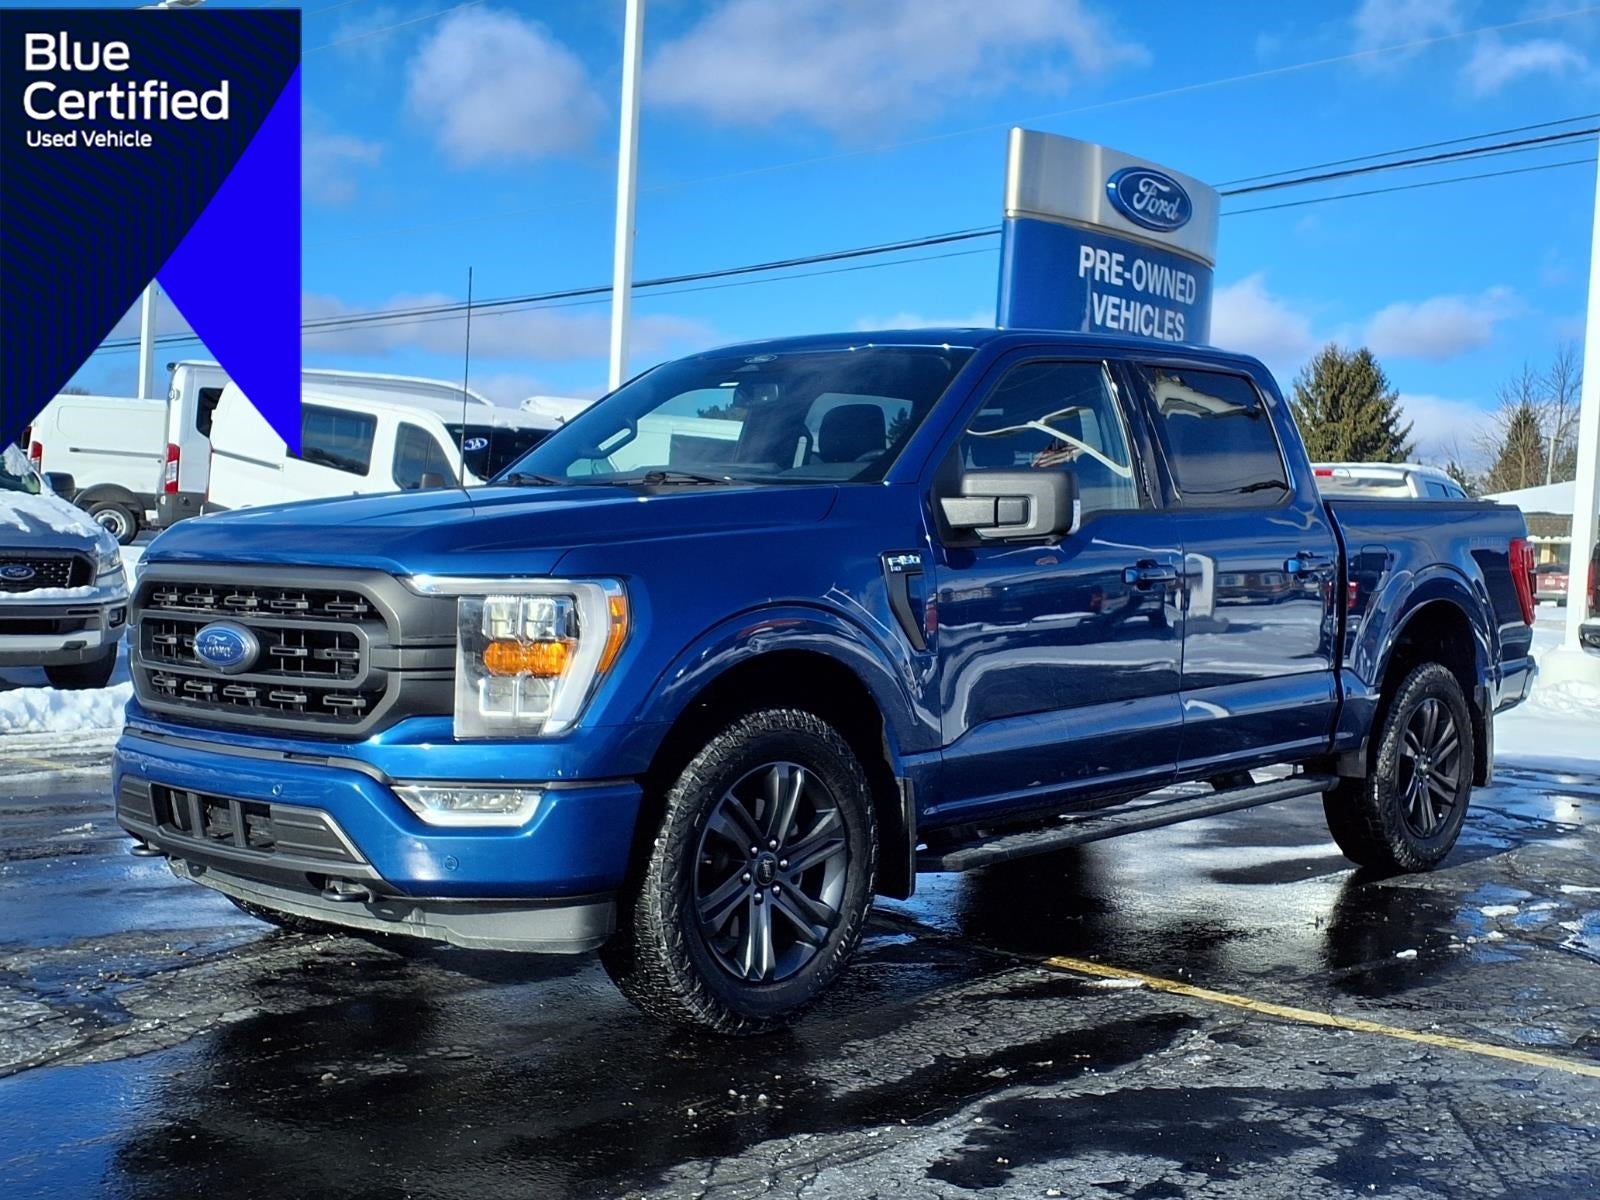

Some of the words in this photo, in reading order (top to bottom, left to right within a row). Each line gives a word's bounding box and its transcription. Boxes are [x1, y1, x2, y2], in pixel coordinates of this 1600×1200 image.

[1132, 177, 1181, 220] Ford
[1078, 245, 1196, 305] PRE-OWNED
[1092, 292, 1184, 342] VEHICLES
